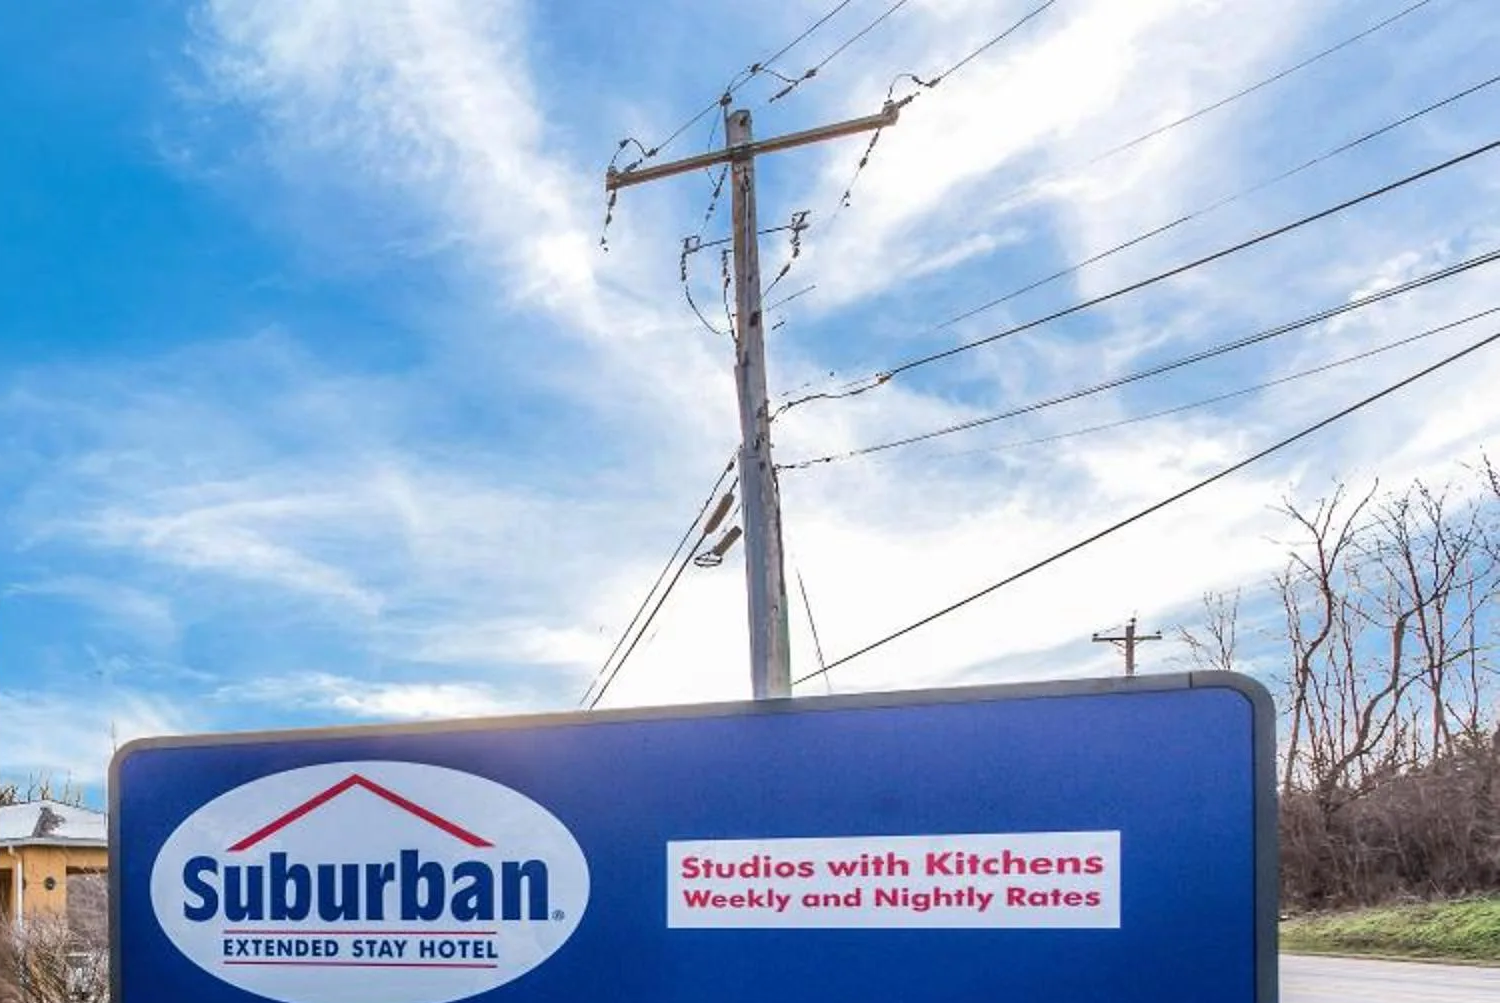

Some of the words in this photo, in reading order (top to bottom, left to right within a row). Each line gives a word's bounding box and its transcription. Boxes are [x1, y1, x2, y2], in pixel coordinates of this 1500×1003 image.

[681, 855, 815, 880] Studios
[827, 852, 910, 877] with
[925, 849, 1104, 876] Kitchens
[182, 849, 549, 923] Suburban
[683, 888, 791, 913] Weekly
[802, 887, 862, 909] and
[874, 887, 994, 913] Nightly
[1006, 886, 1101, 908] Rates
[223, 938, 340, 959] EXTENDED
[351, 937, 406, 960] STAY
[419, 939, 499, 960] HOTEL
